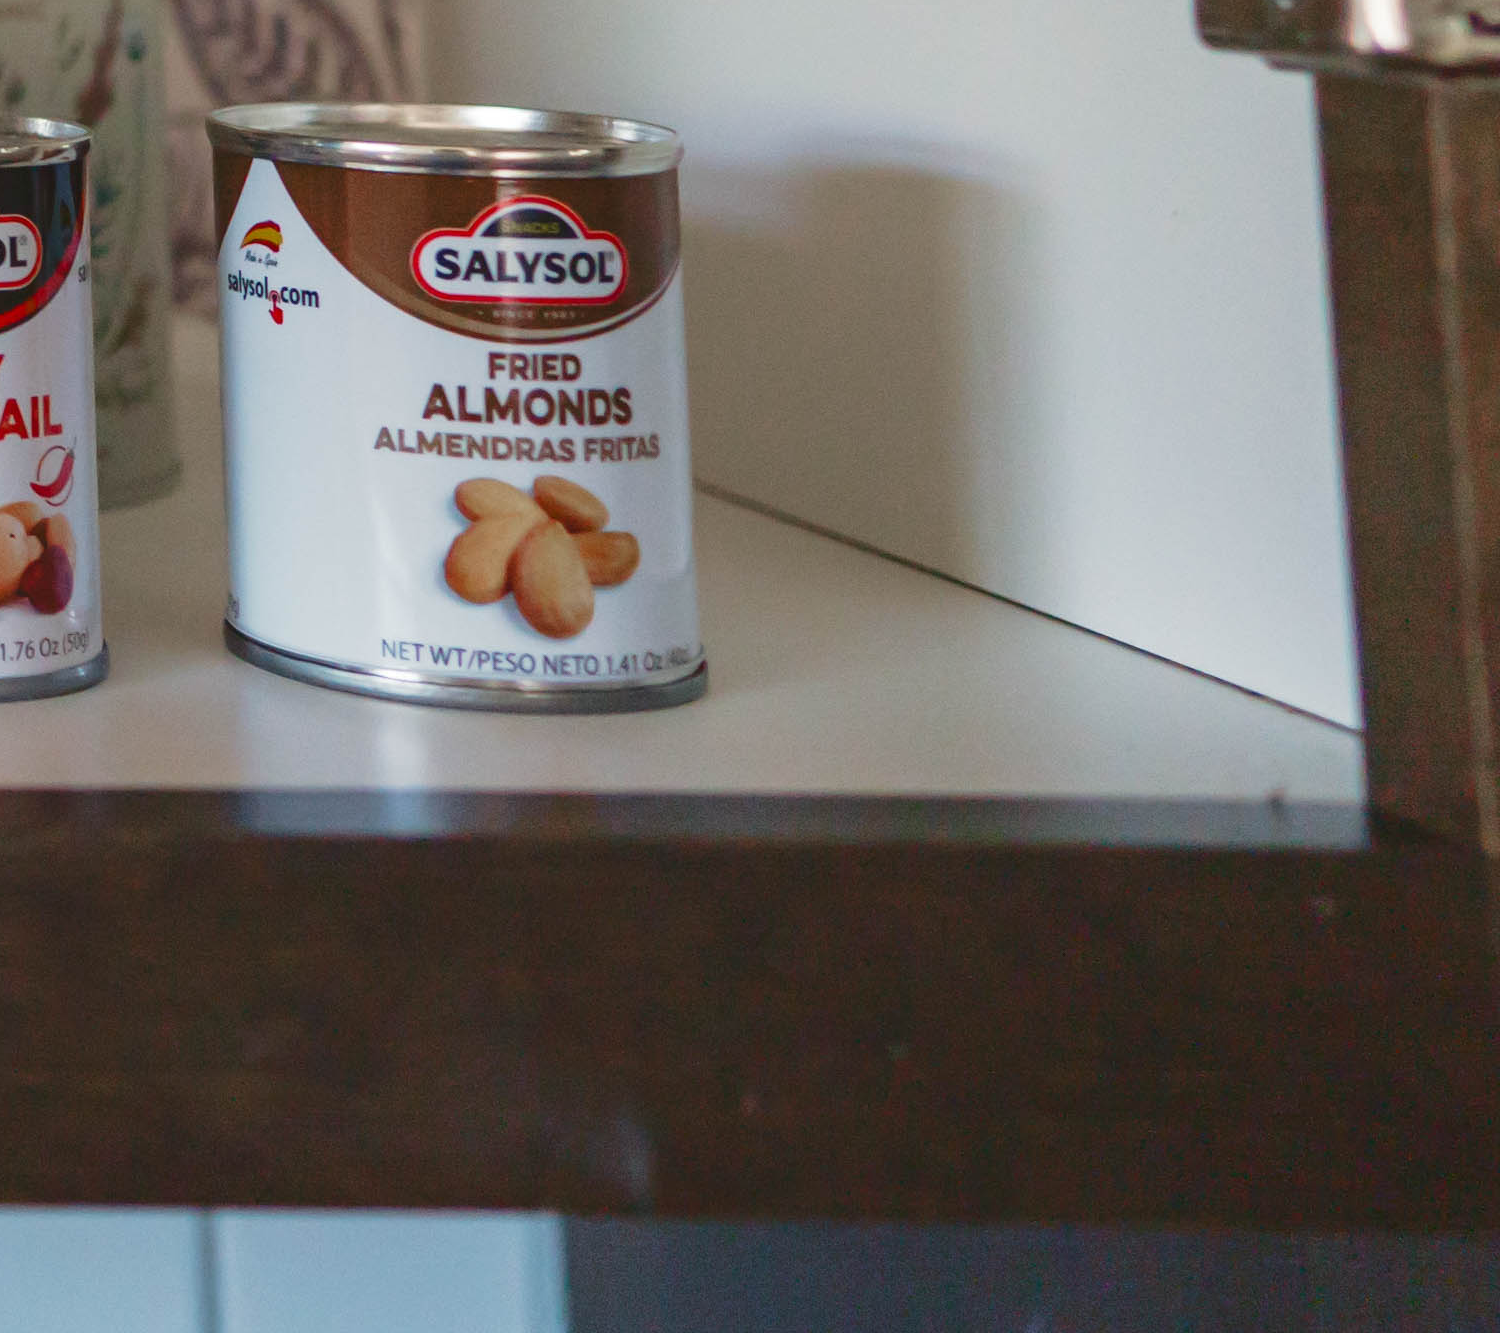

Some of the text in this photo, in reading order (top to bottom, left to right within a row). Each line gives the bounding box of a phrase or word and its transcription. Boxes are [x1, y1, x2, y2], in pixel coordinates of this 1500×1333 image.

[434, 248, 614, 284] SALYSOL
[488, 352, 583, 383] FRIED
[422, 383, 633, 427] ALMONDS
[373, 426, 660, 464] ALMENDRAS FRITAS
[0, 640, 36, 661] 1.76
[39, 638, 60, 657] Oz
[381, 639, 422, 662] NET
[429, 646, 536, 674] WT/PESO
[542, 655, 600, 676] NETO
[605, 654, 640, 677] 1.41
